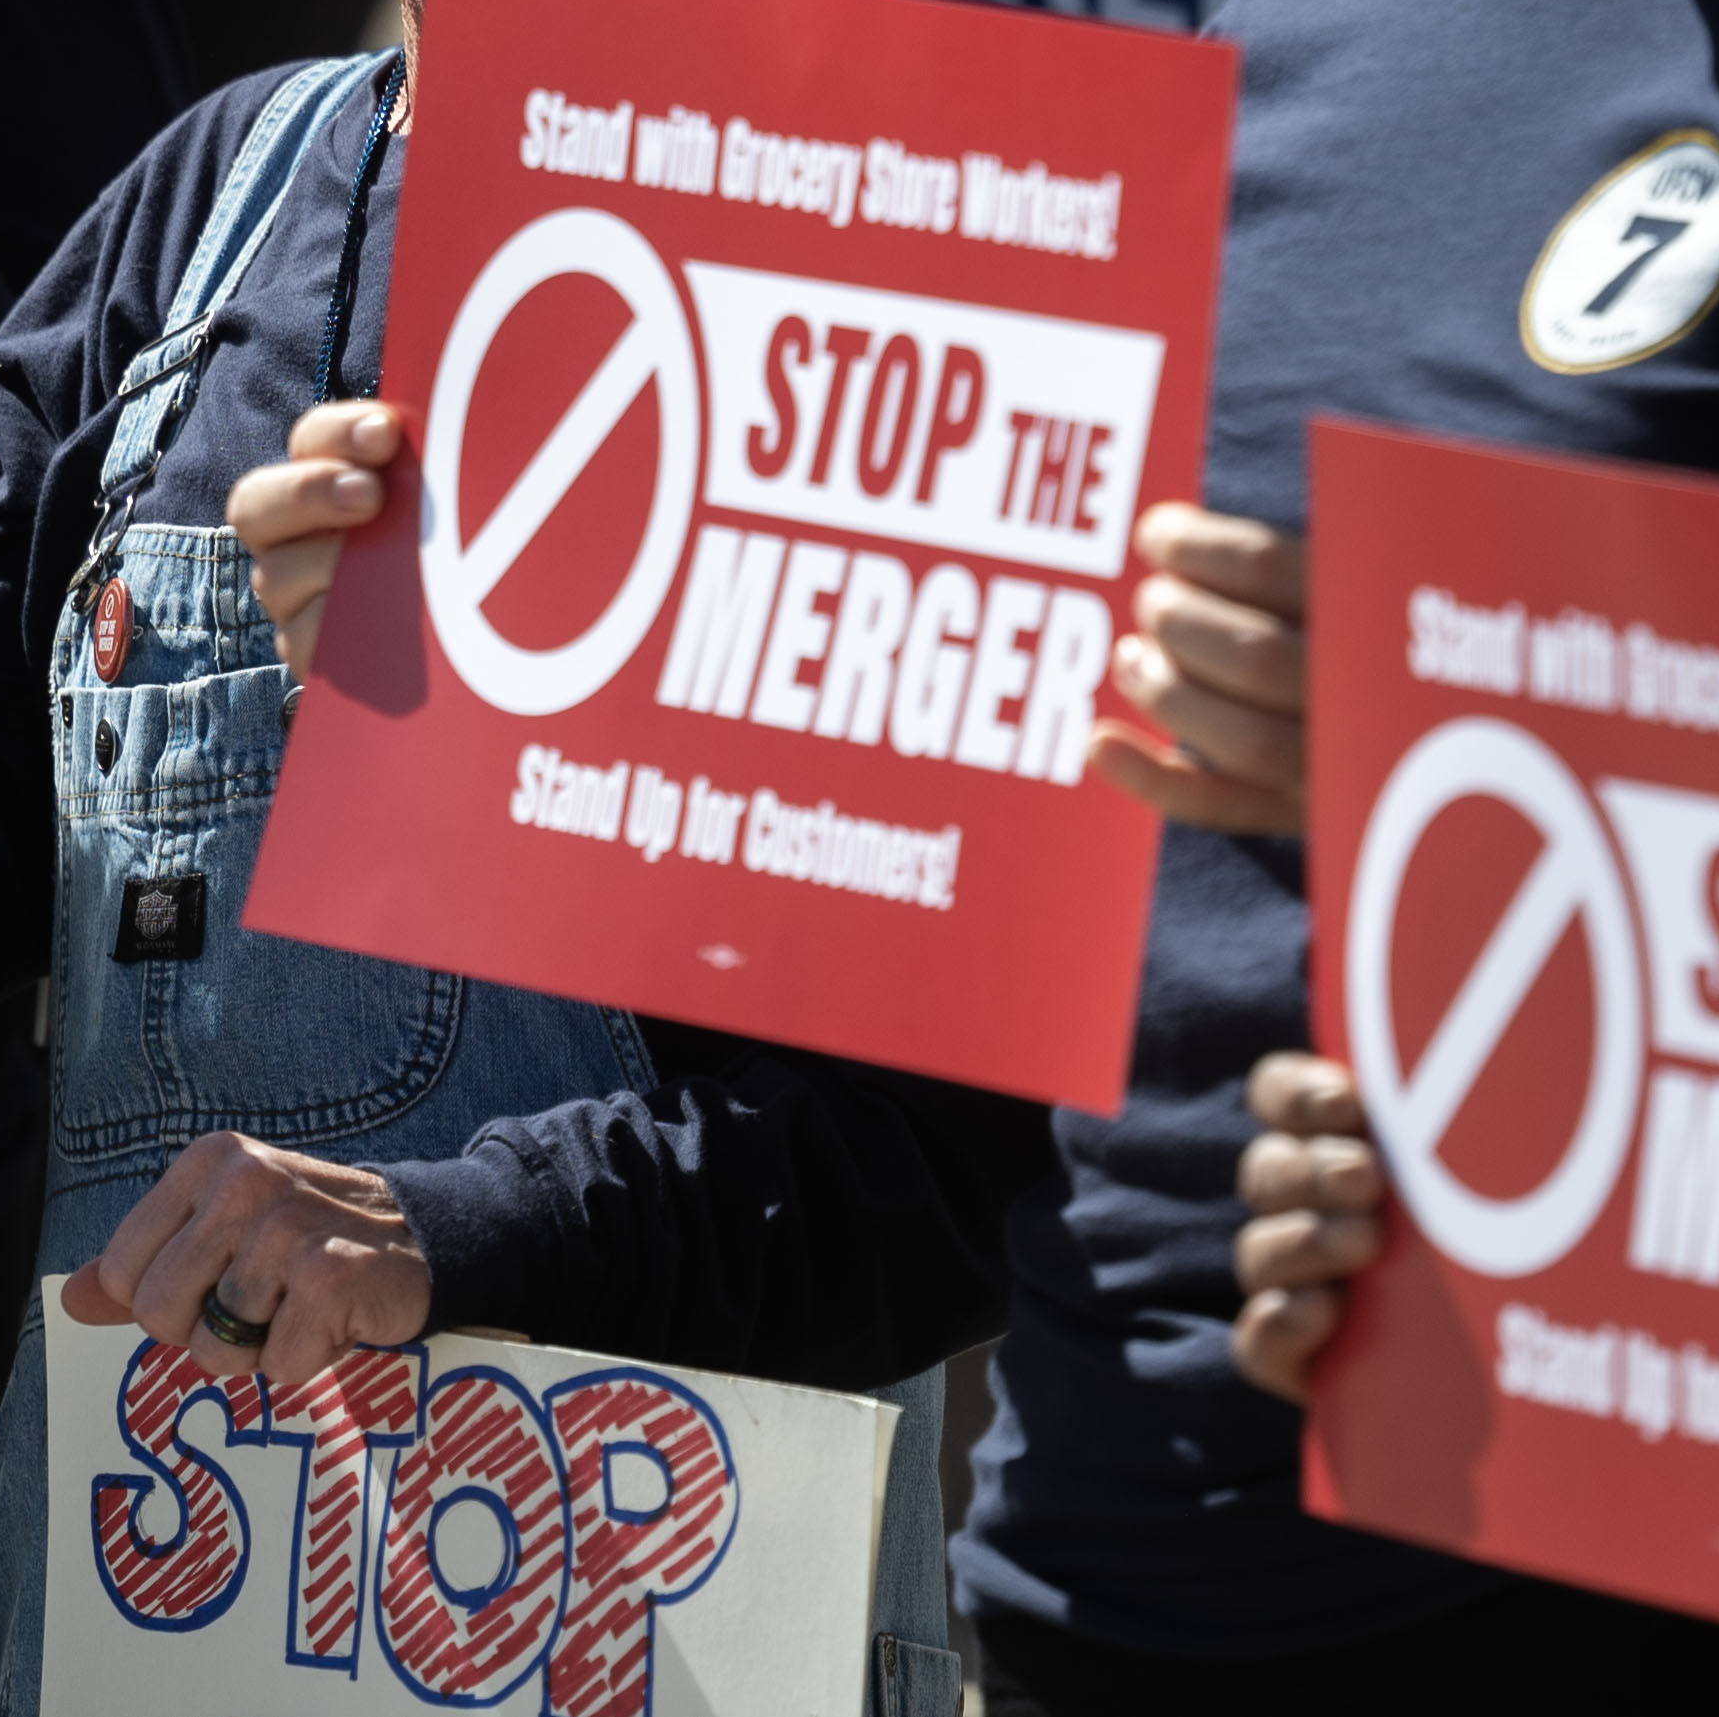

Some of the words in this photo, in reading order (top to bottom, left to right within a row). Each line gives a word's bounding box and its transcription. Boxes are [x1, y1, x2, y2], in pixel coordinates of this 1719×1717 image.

[520, 87, 634, 182] Stand
[633, 102, 718, 196] with
[719, 116, 863, 228] Grocery
[860, 136, 960, 234] Store
[959, 151, 1122, 261] Workers!
[1618, 214, 1693, 317] 7
[745, 313, 988, 504] STOP
[997, 409, 1115, 536] THE
[655, 523, 1114, 787] MERGER
[1406, 584, 1527, 699] Stand
[1530, 604, 1615, 717] with
[510, 743, 630, 842] Stand
[626, 764, 683, 864] Up
[680, 774, 746, 865] for
[743, 787, 963, 912] Customers!
[1497, 1301, 1617, 1419] Stand
[1618, 1328, 1677, 1445] Up
[92, 1334, 739, 1717] STOP
